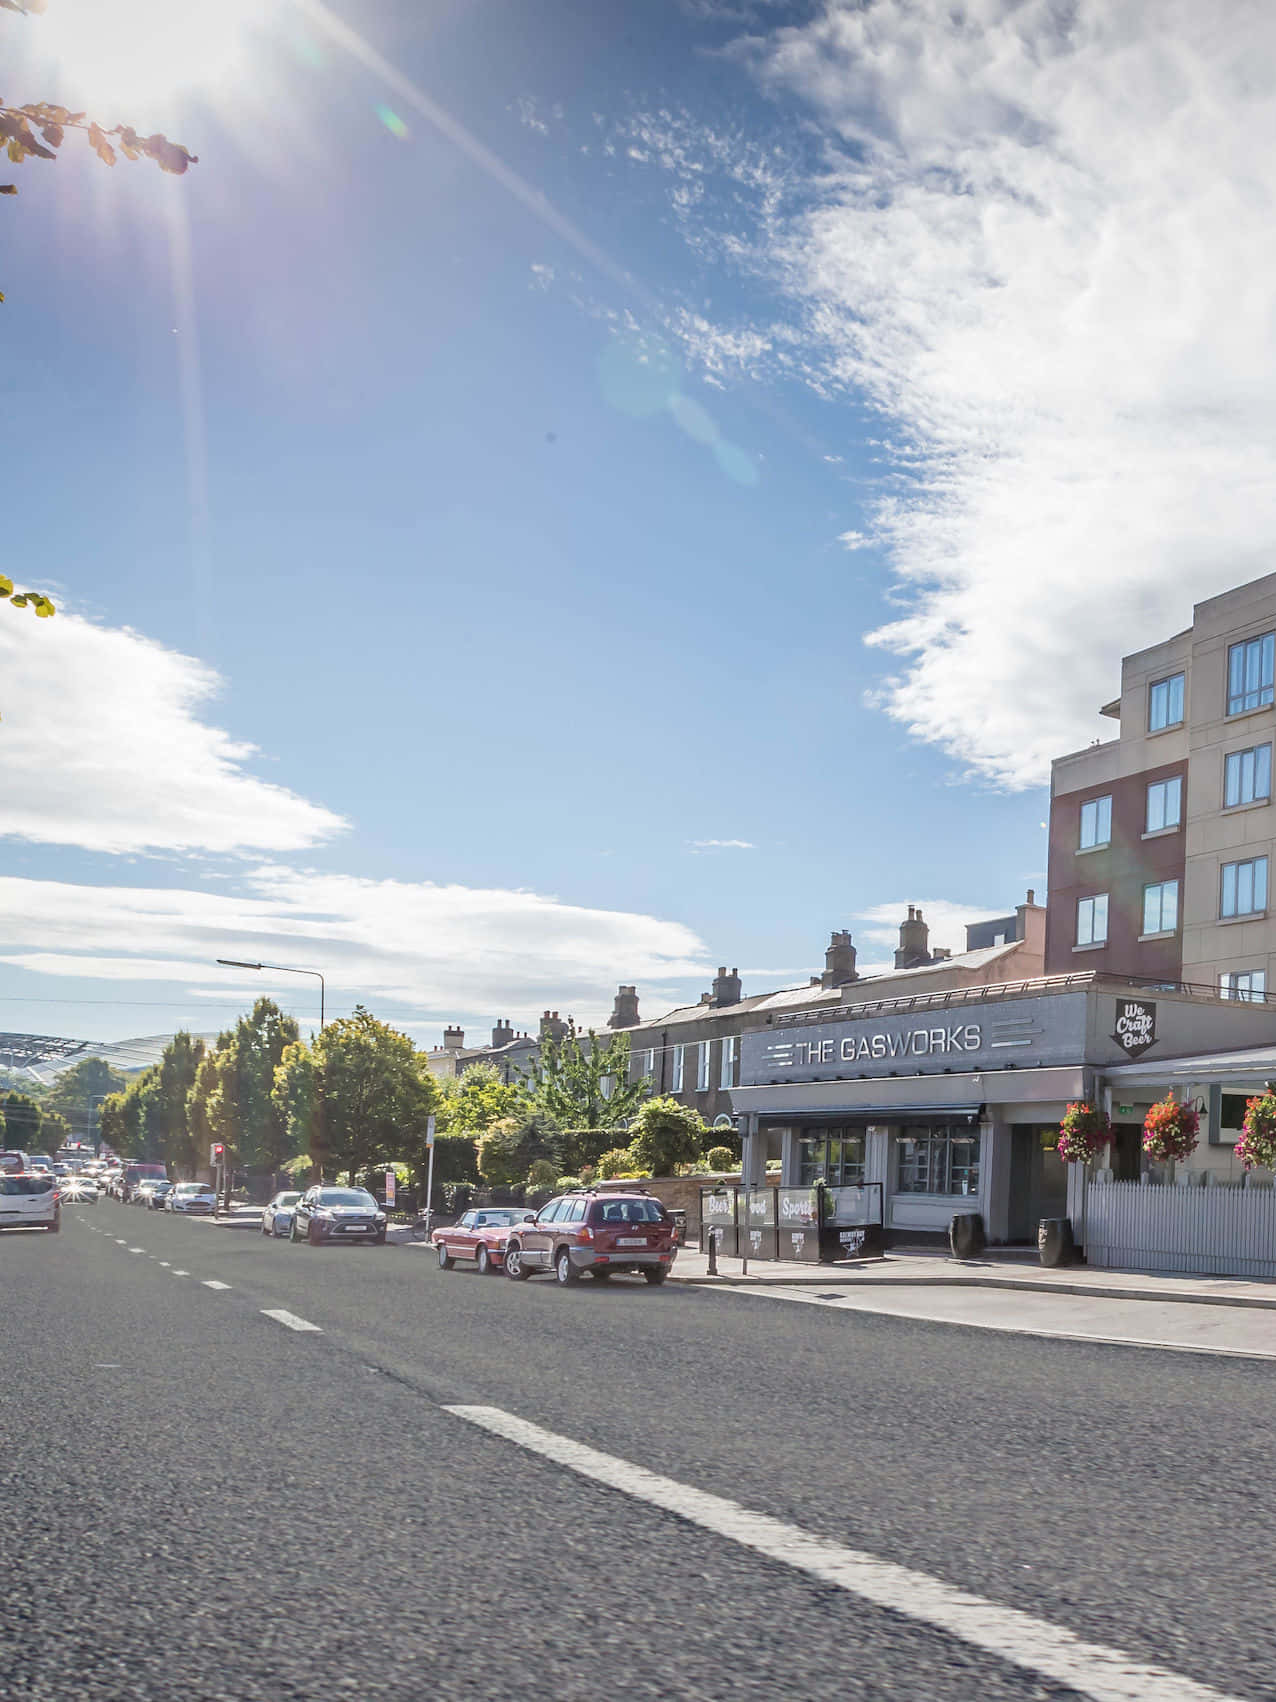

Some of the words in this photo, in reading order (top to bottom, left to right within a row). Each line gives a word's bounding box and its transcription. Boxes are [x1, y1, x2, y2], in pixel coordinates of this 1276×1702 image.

[1124, 1003, 1145, 1018] We
[1116, 1015, 1153, 1035] Craft
[796, 1039, 834, 1065] THE
[840, 1024, 981, 1062] GASWORKS
[1121, 1032, 1152, 1048] Beer
[746, 1199, 767, 1216] ood
